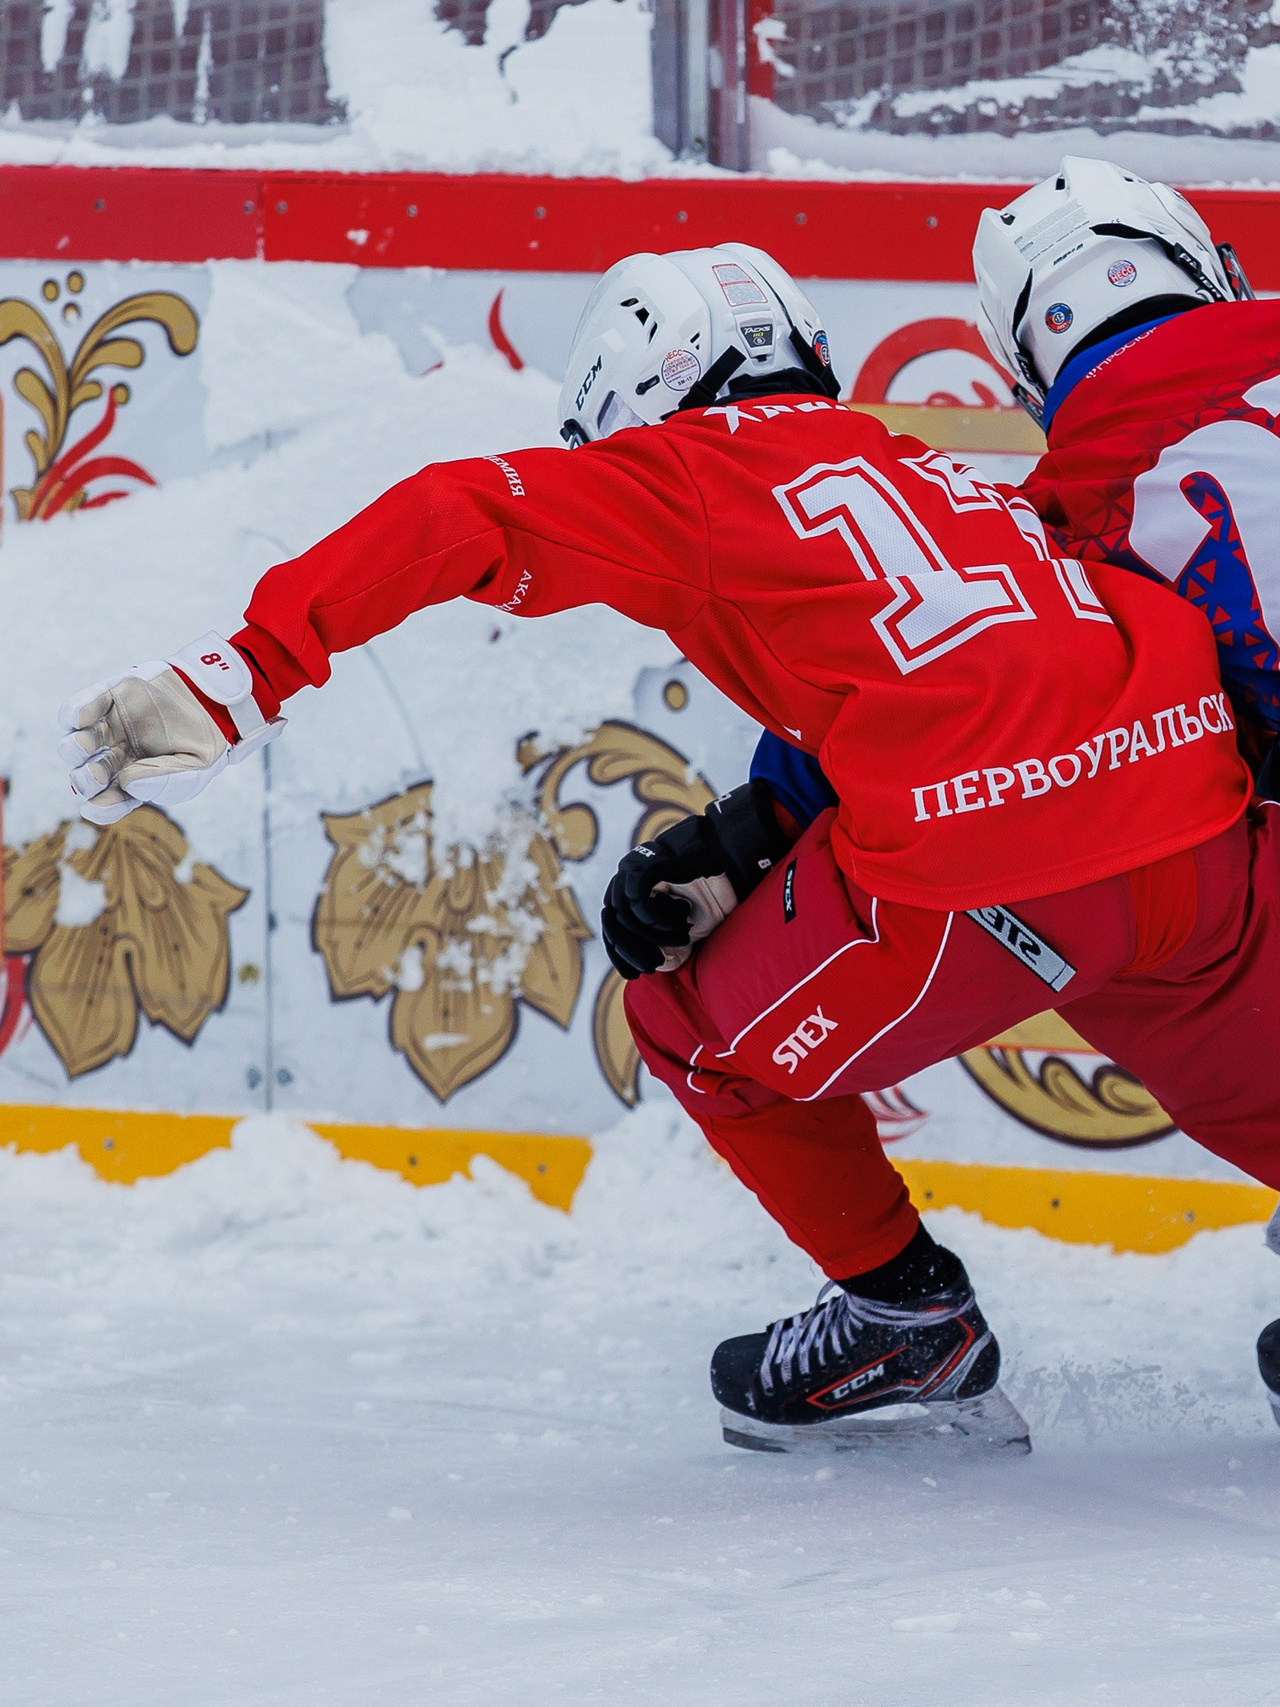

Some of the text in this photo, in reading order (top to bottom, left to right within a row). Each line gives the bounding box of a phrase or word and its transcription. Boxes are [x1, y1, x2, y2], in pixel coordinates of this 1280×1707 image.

[575, 354, 603, 412] CCM
[911, 692, 1235, 823] ПЕРВОУРАЛЬСК
[772, 1004, 839, 1075] STEX
[832, 1363, 885, 1400] CCM
